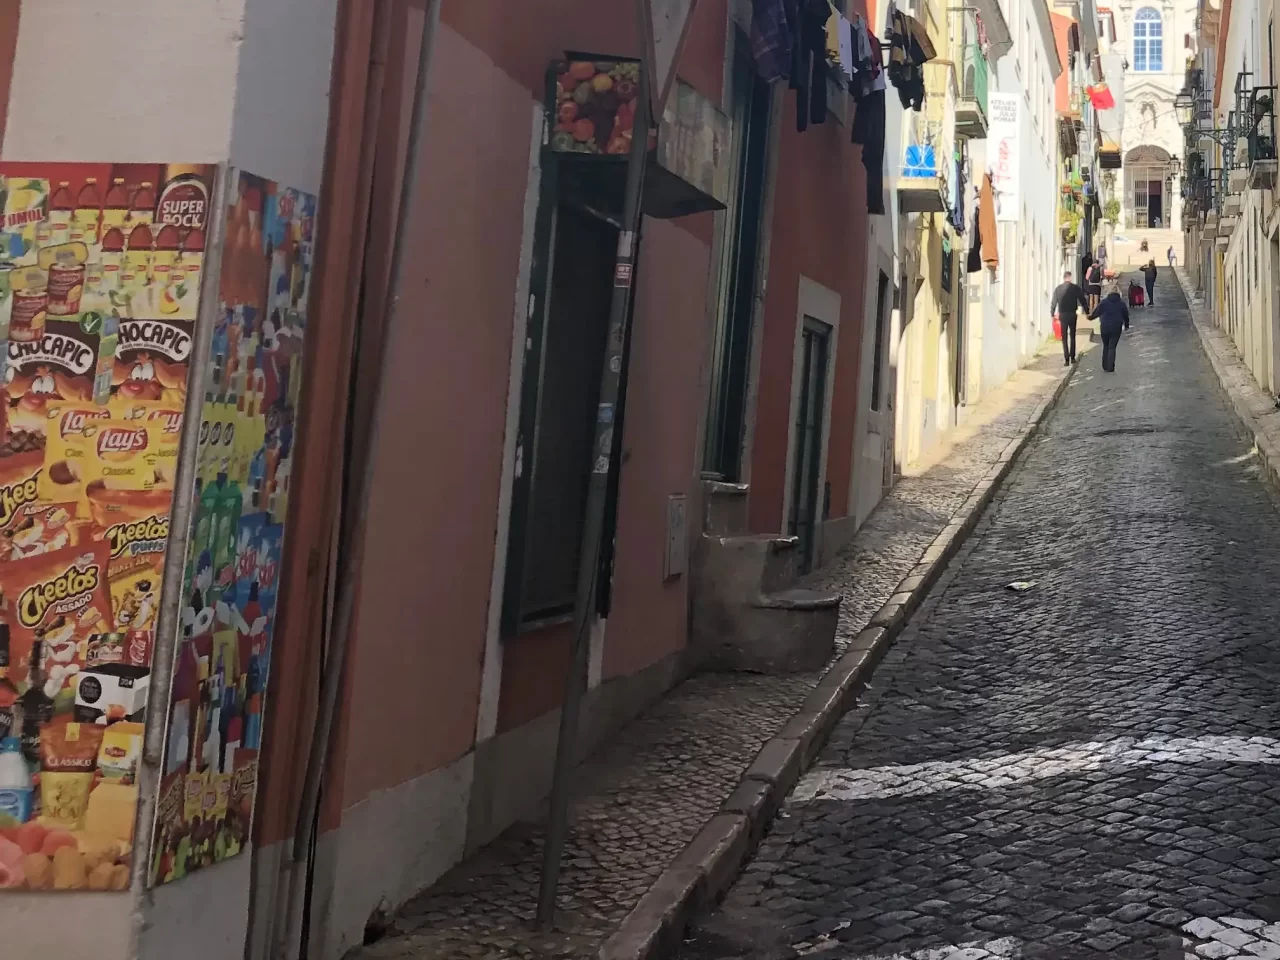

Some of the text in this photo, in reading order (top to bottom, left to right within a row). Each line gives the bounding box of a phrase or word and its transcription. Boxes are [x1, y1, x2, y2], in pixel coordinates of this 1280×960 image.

[992, 115, 1017, 123] POMAR
[162, 200, 204, 214] SUPER
[162, 213, 202, 227] BOCK
[101, 466, 136, 476] Classic
[103, 515, 170, 558] Cheetos
[20, 565, 98, 627] Cheetos
[55, 594, 93, 614] ASSADO
[47, 756, 92, 767] CLASSICO
